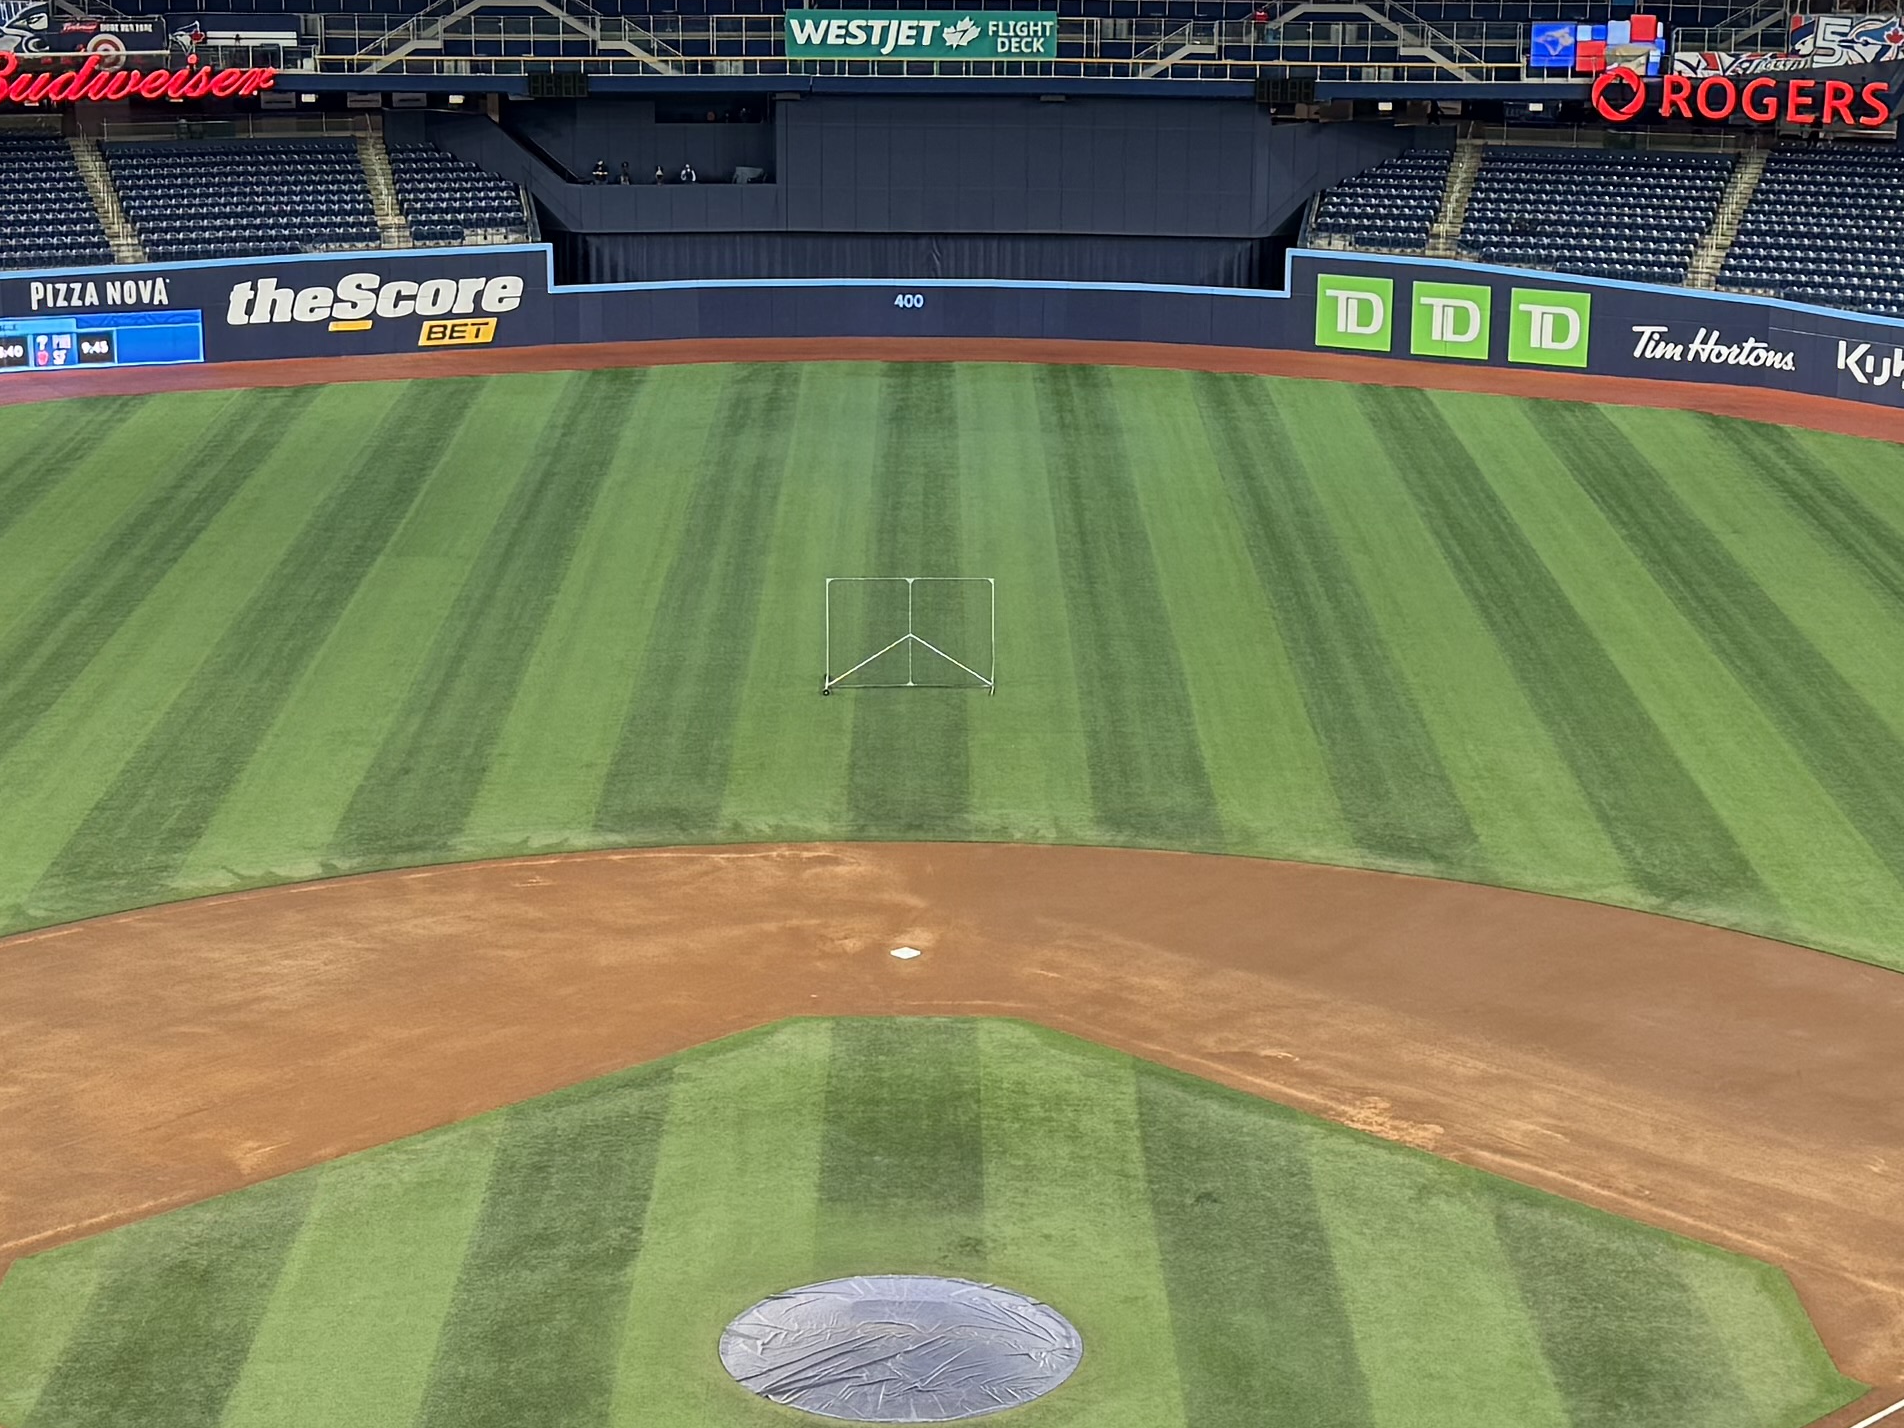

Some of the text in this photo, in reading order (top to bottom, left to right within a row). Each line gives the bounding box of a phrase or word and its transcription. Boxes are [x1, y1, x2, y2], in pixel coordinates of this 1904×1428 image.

[790, 20, 1054, 55] WESTJET FLIGHT
[997, 38, 1044, 53] DECK
[1660, 75, 1890, 127] ROGERS
[31, 277, 169, 310] PIZZA NOVA
[226, 272, 524, 325] theScore
[894, 293, 923, 309] 400
[1326, 289, 1384, 334] TD
[427, 322, 489, 341] BET
[1420, 296, 1480, 342] TD
[1518, 304, 1580, 350] TD
[1632, 325, 1683, 361] Tim
